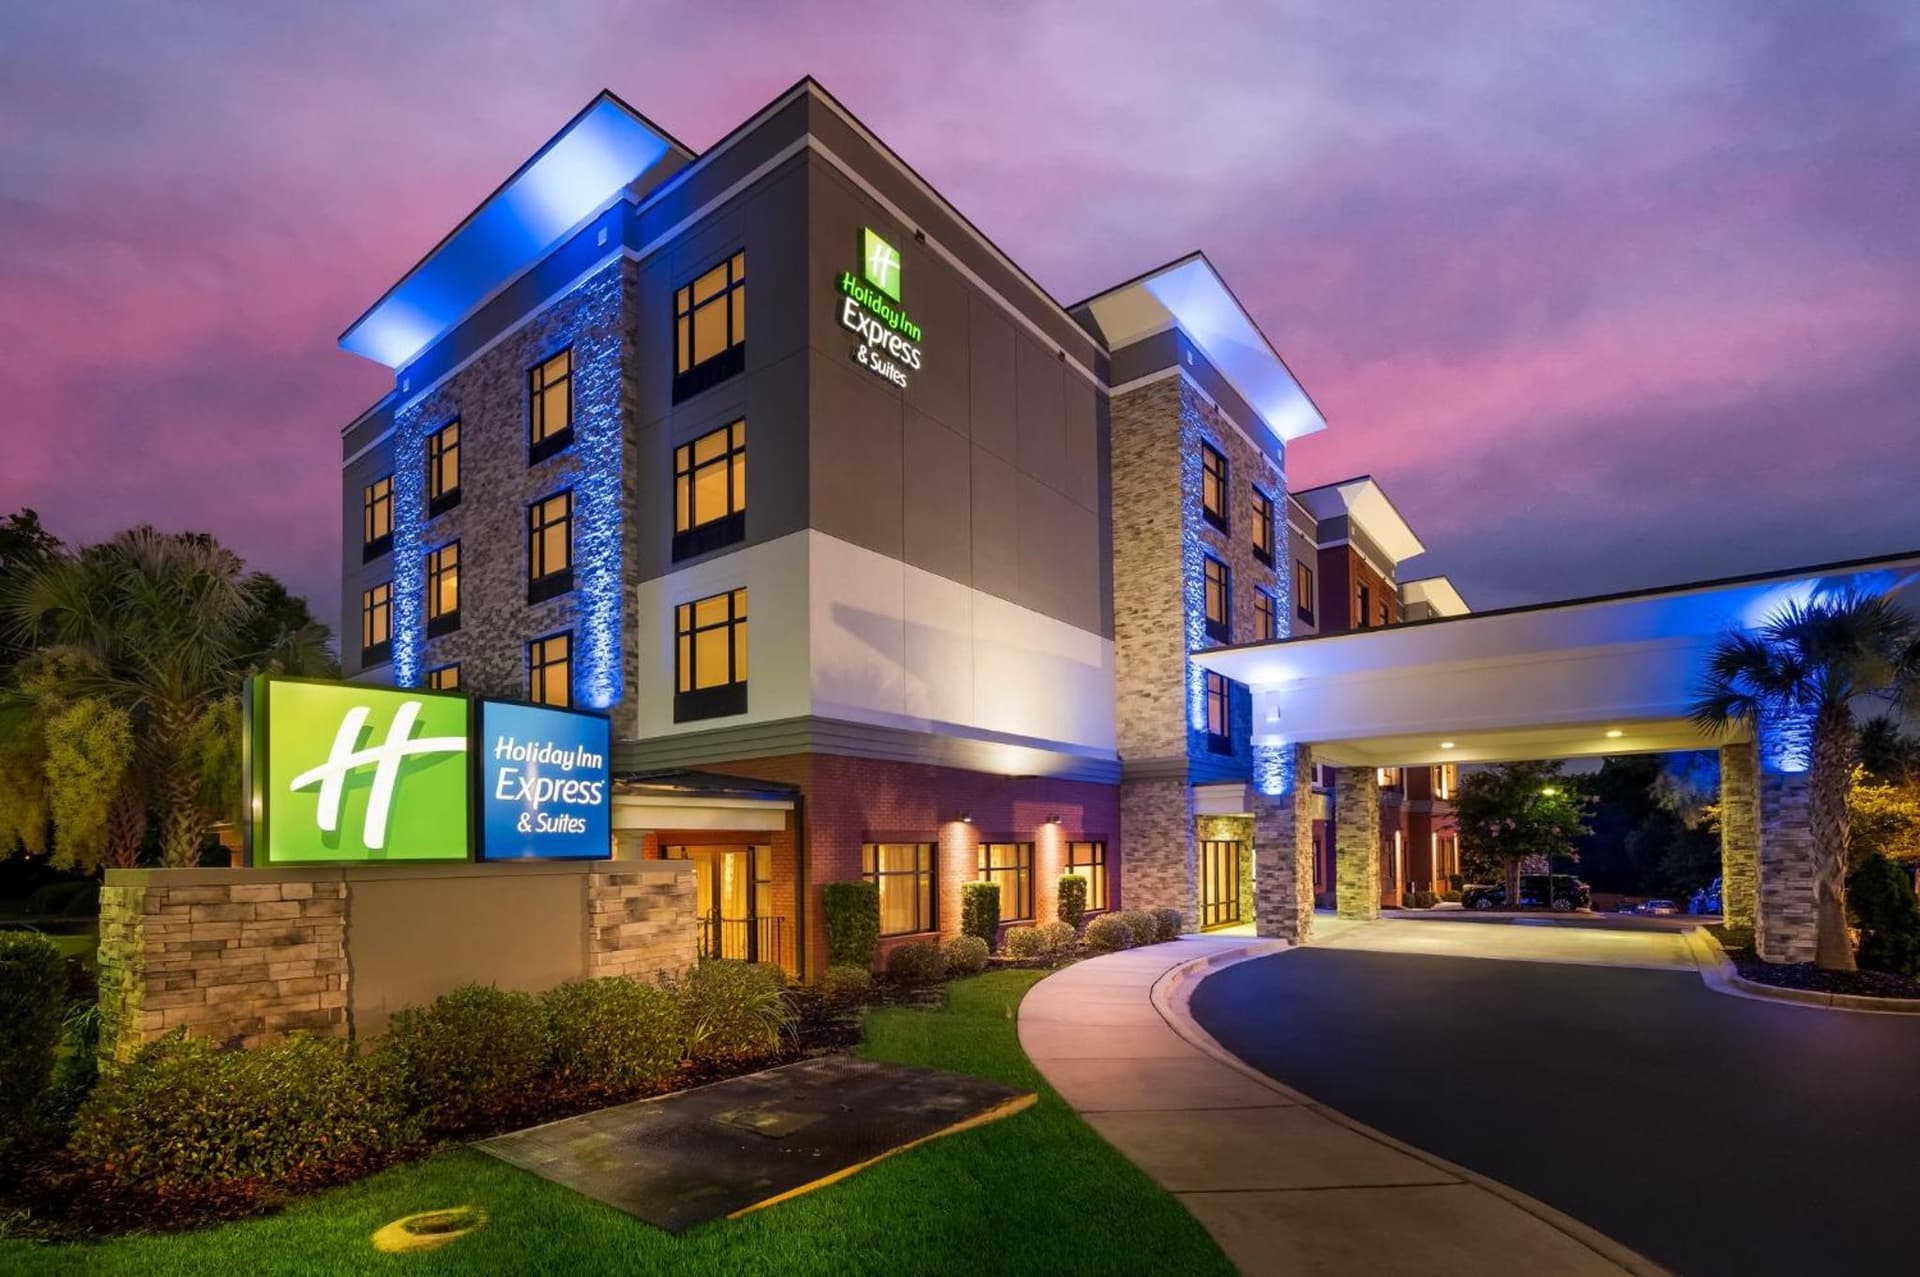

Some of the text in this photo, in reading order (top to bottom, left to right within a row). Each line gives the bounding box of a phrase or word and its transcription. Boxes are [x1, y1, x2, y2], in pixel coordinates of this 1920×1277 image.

[843, 297, 921, 370] Express
[857, 344, 907, 388] & Suites
[290, 701, 467, 850] H
[495, 767, 603, 810] Express
[517, 811, 586, 834] & Suites
